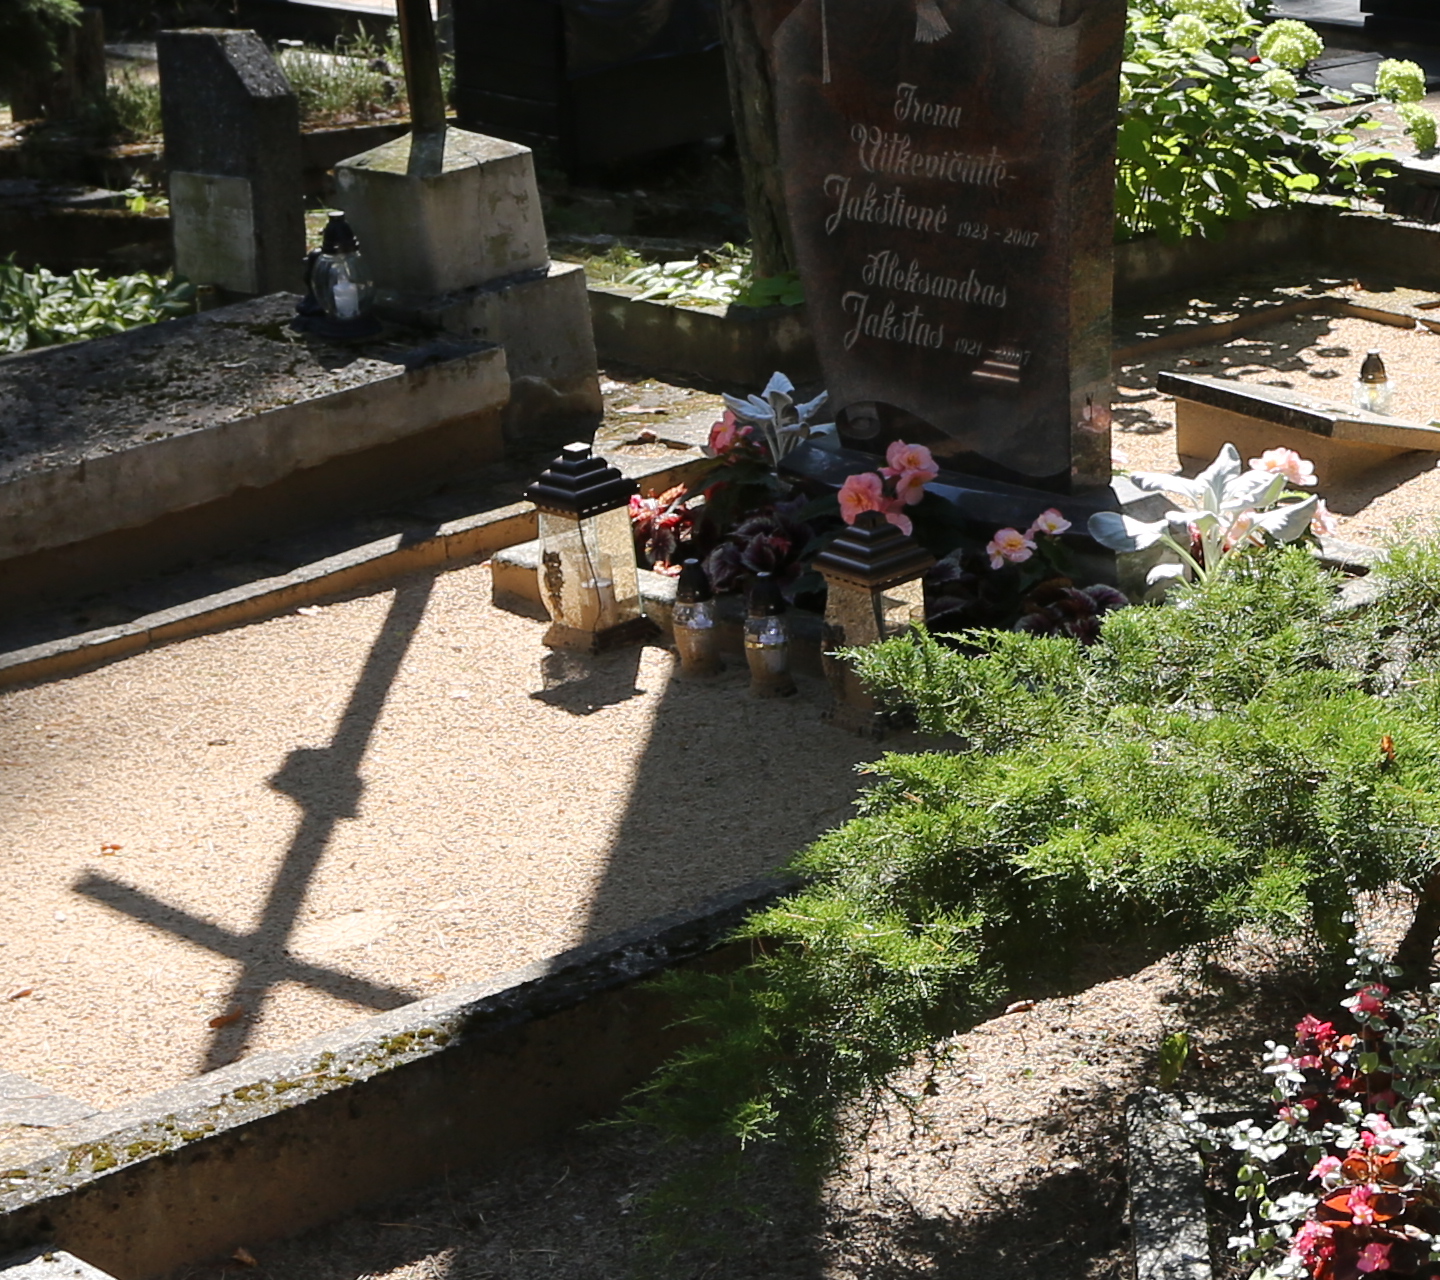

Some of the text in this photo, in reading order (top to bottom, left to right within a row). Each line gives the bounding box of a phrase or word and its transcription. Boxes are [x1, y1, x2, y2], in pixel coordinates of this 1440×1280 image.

[894, 81, 963, 129] Irena
[823, 173, 948, 236] Jakštienė
[1003, 227, 1040, 248] 2007
[862, 250, 1008, 308] Aleksandras
[841, 290, 945, 351] Jakštas
